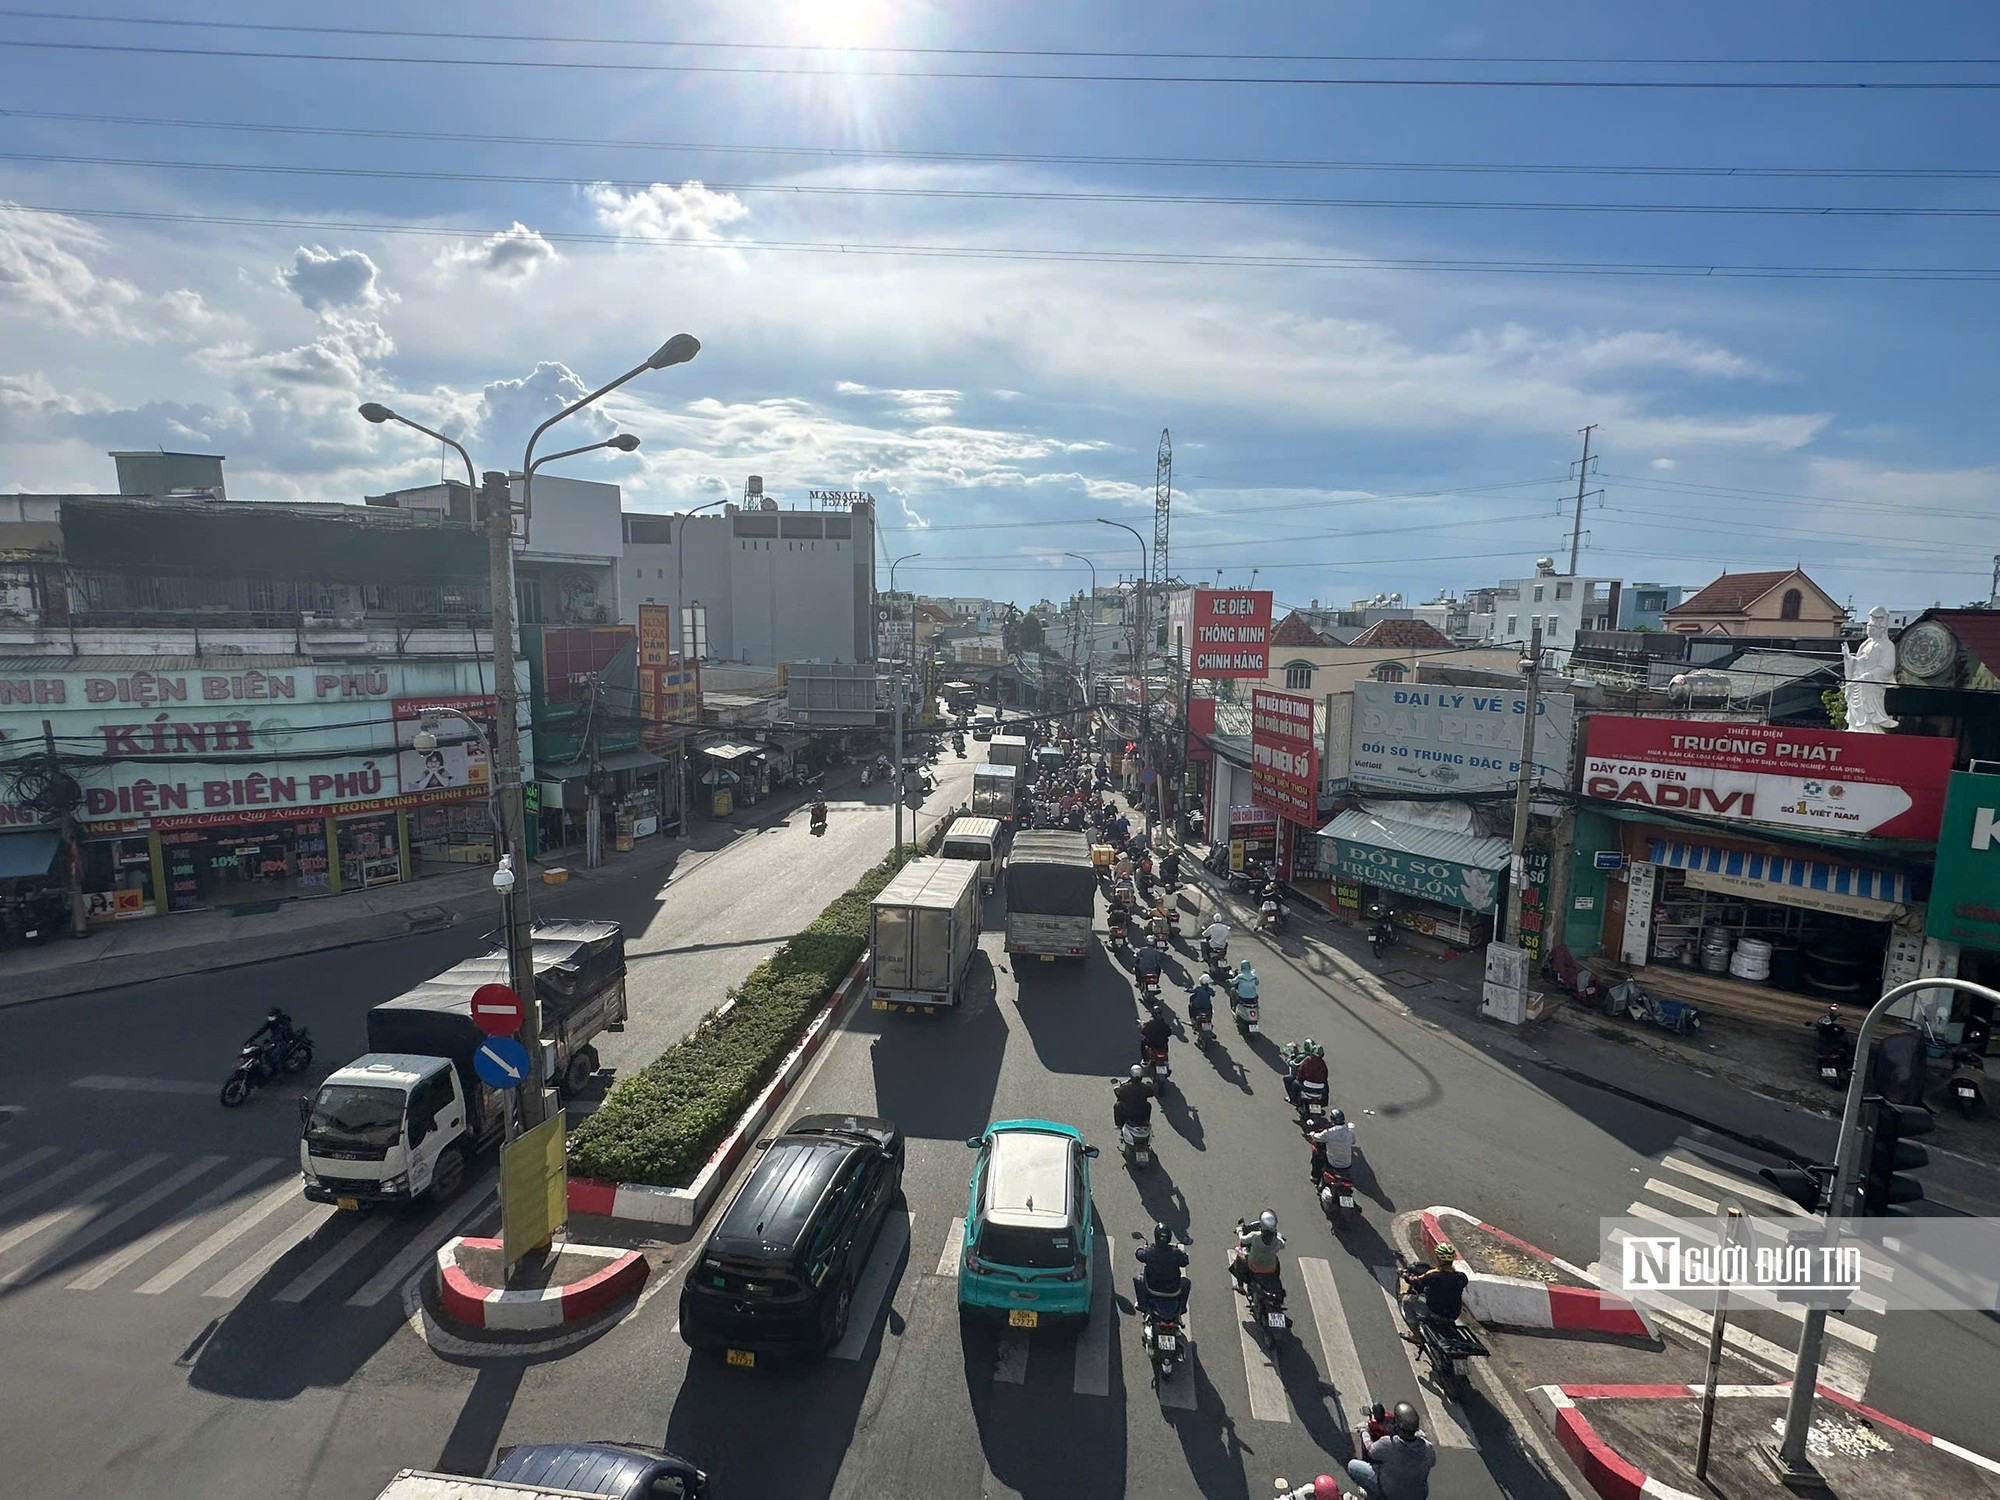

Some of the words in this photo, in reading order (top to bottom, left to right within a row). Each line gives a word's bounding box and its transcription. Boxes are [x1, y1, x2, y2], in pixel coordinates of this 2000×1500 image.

[809, 490, 865, 500] MASSAGE
[1212, 598, 1226, 615] XE
[1228, 595, 1254, 619] ĐIỆN
[643, 629, 665, 639] NGA
[1199, 623, 1235, 643] THÔNG
[1238, 626, 1265, 643] MINH
[1197, 649, 1231, 670] CHÍNH
[1233, 649, 1263, 670] HÃNG
[84, 671, 188, 707] ĐIỆN
[202, 671, 297, 700] BIÊN
[315, 666, 389, 697] PHỦ
[1280, 697, 1293, 718] ĐIỆN
[1293, 701, 1310, 721] THOẠI
[1393, 691, 1430, 709] ĐẠI
[1438, 692, 1465, 709] LÝ
[1472, 694, 1503, 713] VÉ
[98, 712, 255, 755] KÍNH
[1361, 708, 1429, 744] ĐẠI
[1752, 729, 1761, 738] BỊ
[1671, 733, 1767, 755] TRƯỜNG
[1775, 741, 1843, 762] PHÁT
[1253, 743, 1272, 772] PHỤ
[1271, 746, 1293, 777] KIỆN
[1294, 750, 1310, 779] SỐ
[1354, 759, 1382, 770] Vietlott
[1390, 742, 1408, 757] SỐ
[1415, 747, 1464, 765] TRÚNG
[1508, 761, 1547, 777] BỆT
[1590, 761, 1616, 774] DÂY
[1618, 764, 1647, 777] CÁP
[1651, 768, 1687, 783] ĐIỆN
[85, 778, 188, 817] ĐIỆN
[203, 771, 298, 808] BIÊN
[309, 760, 382, 800] PHỦ
[1587, 777, 1755, 817] CADIVI
[1780, 804, 1794, 814] SỐ
[1796, 801, 1807, 816] 1
[1834, 811, 1859, 821] NAM
[210, 855, 240, 869] 10%
[1408, 862, 1451, 880] SỐ
[1339, 860, 1408, 887] TRÚNG
[1412, 878, 1461, 899] LỚN
